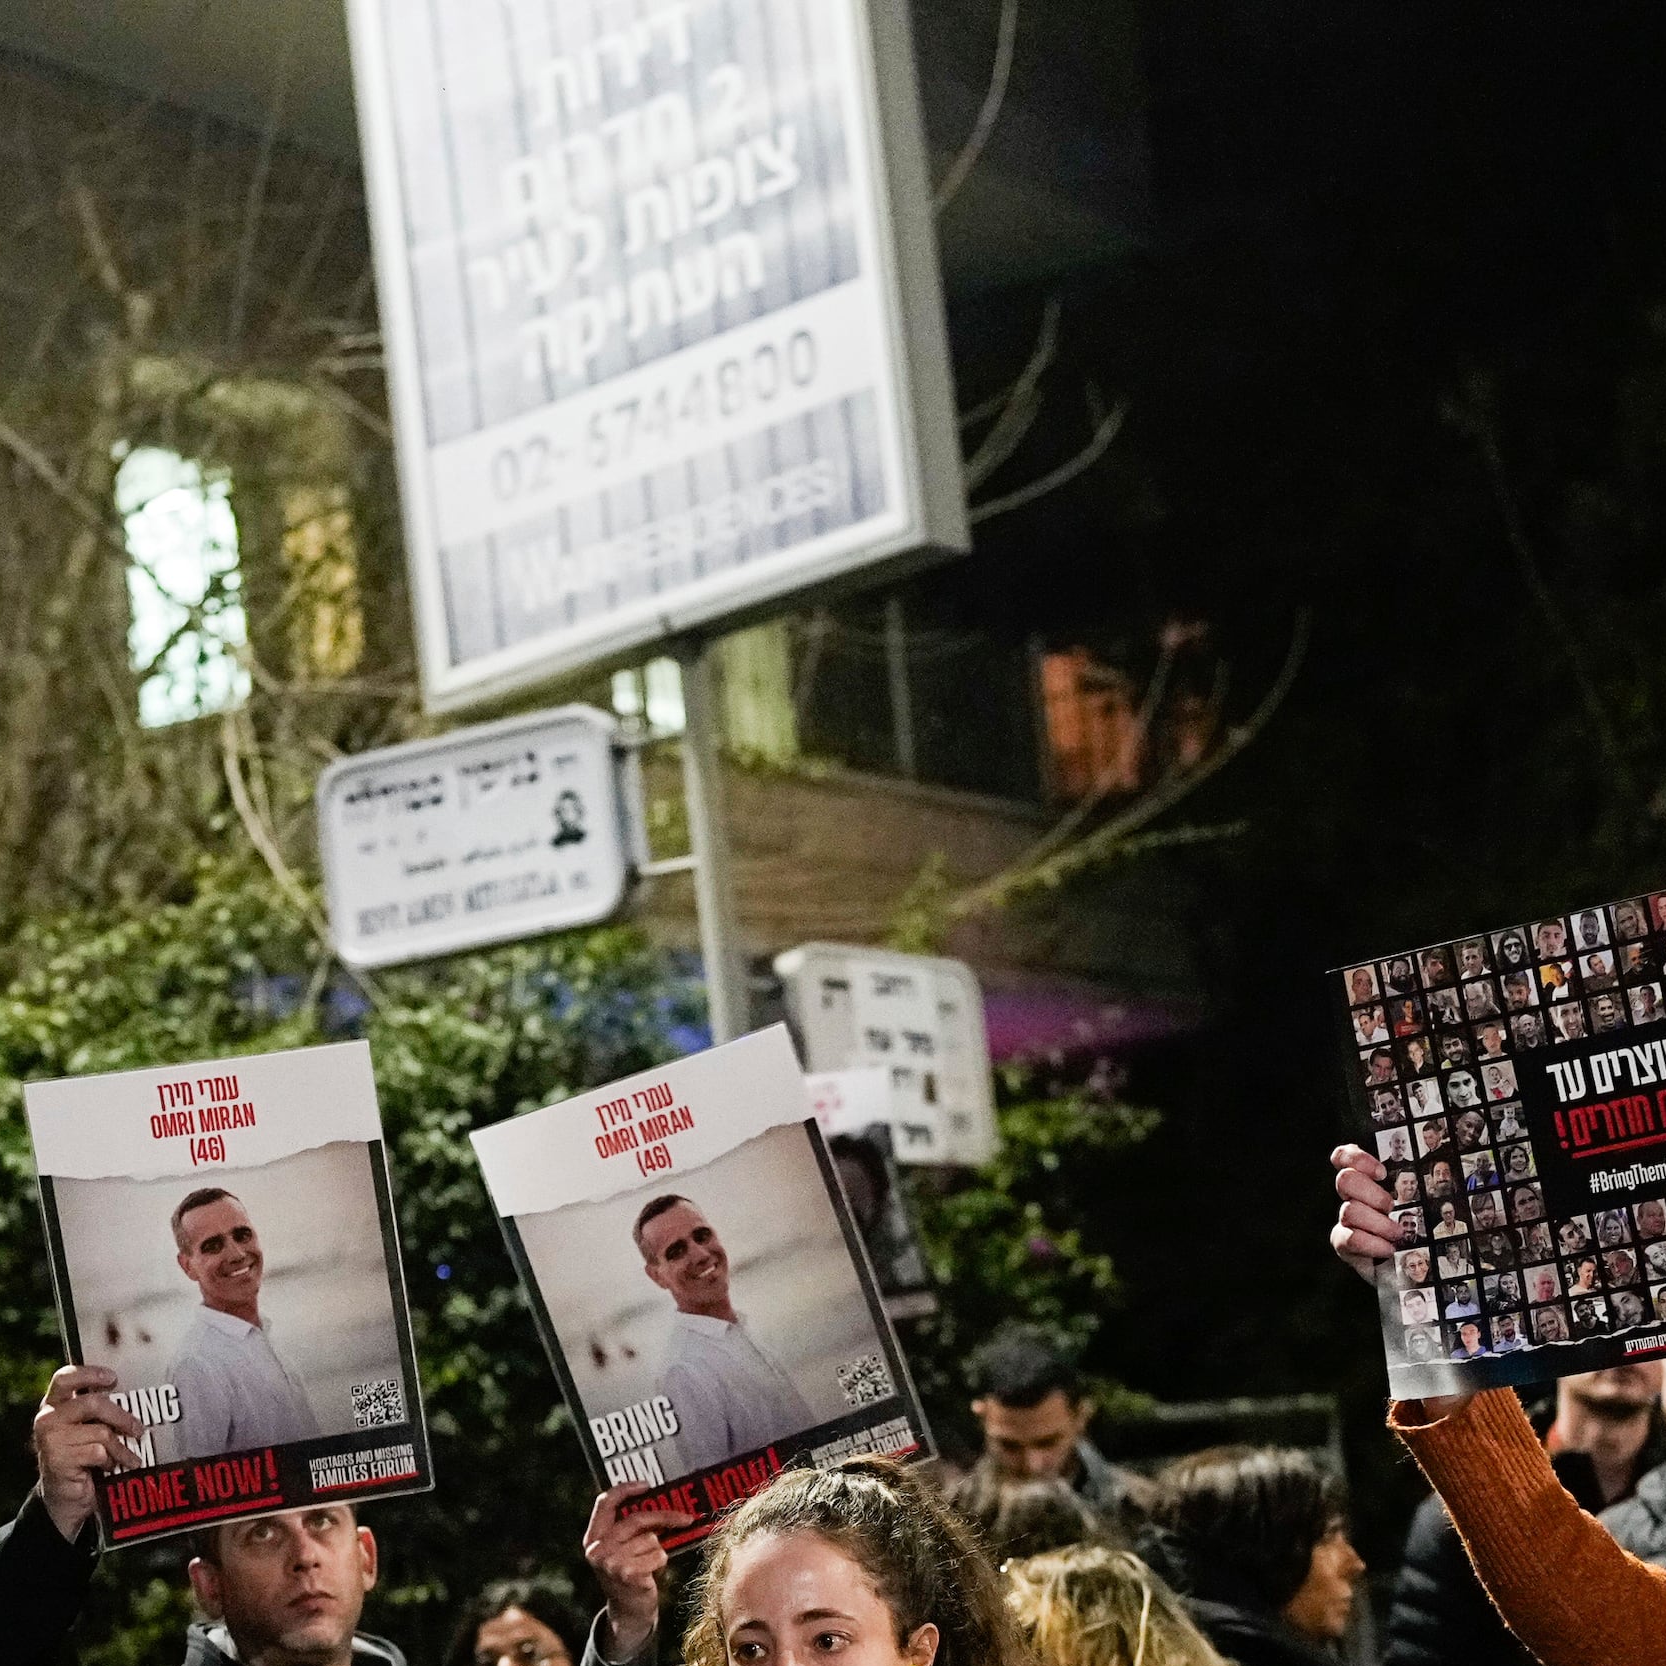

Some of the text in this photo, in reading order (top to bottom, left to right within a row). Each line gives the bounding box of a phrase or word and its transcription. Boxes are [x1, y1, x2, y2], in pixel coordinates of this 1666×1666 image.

[157, 1075, 239, 1112] עמרי מירן
[1545, 1059, 1587, 1103] עד
[150, 1102, 256, 1139] OMRI MIRAN
[595, 1082, 674, 1132] עמרי מירן
[190, 1134, 226, 1166] (46)
[595, 1105, 695, 1159] OMRI MIRAN
[636, 1142, 673, 1178] (46)
[588, 1394, 680, 1460] BRING
[308, 1443, 414, 1473] HOSTAGES AND MISSING
[311, 1457, 417, 1489] FAMILIES FORUM
[106, 1470, 189, 1523] HOME
[194, 1446, 279, 1501] NOW!
